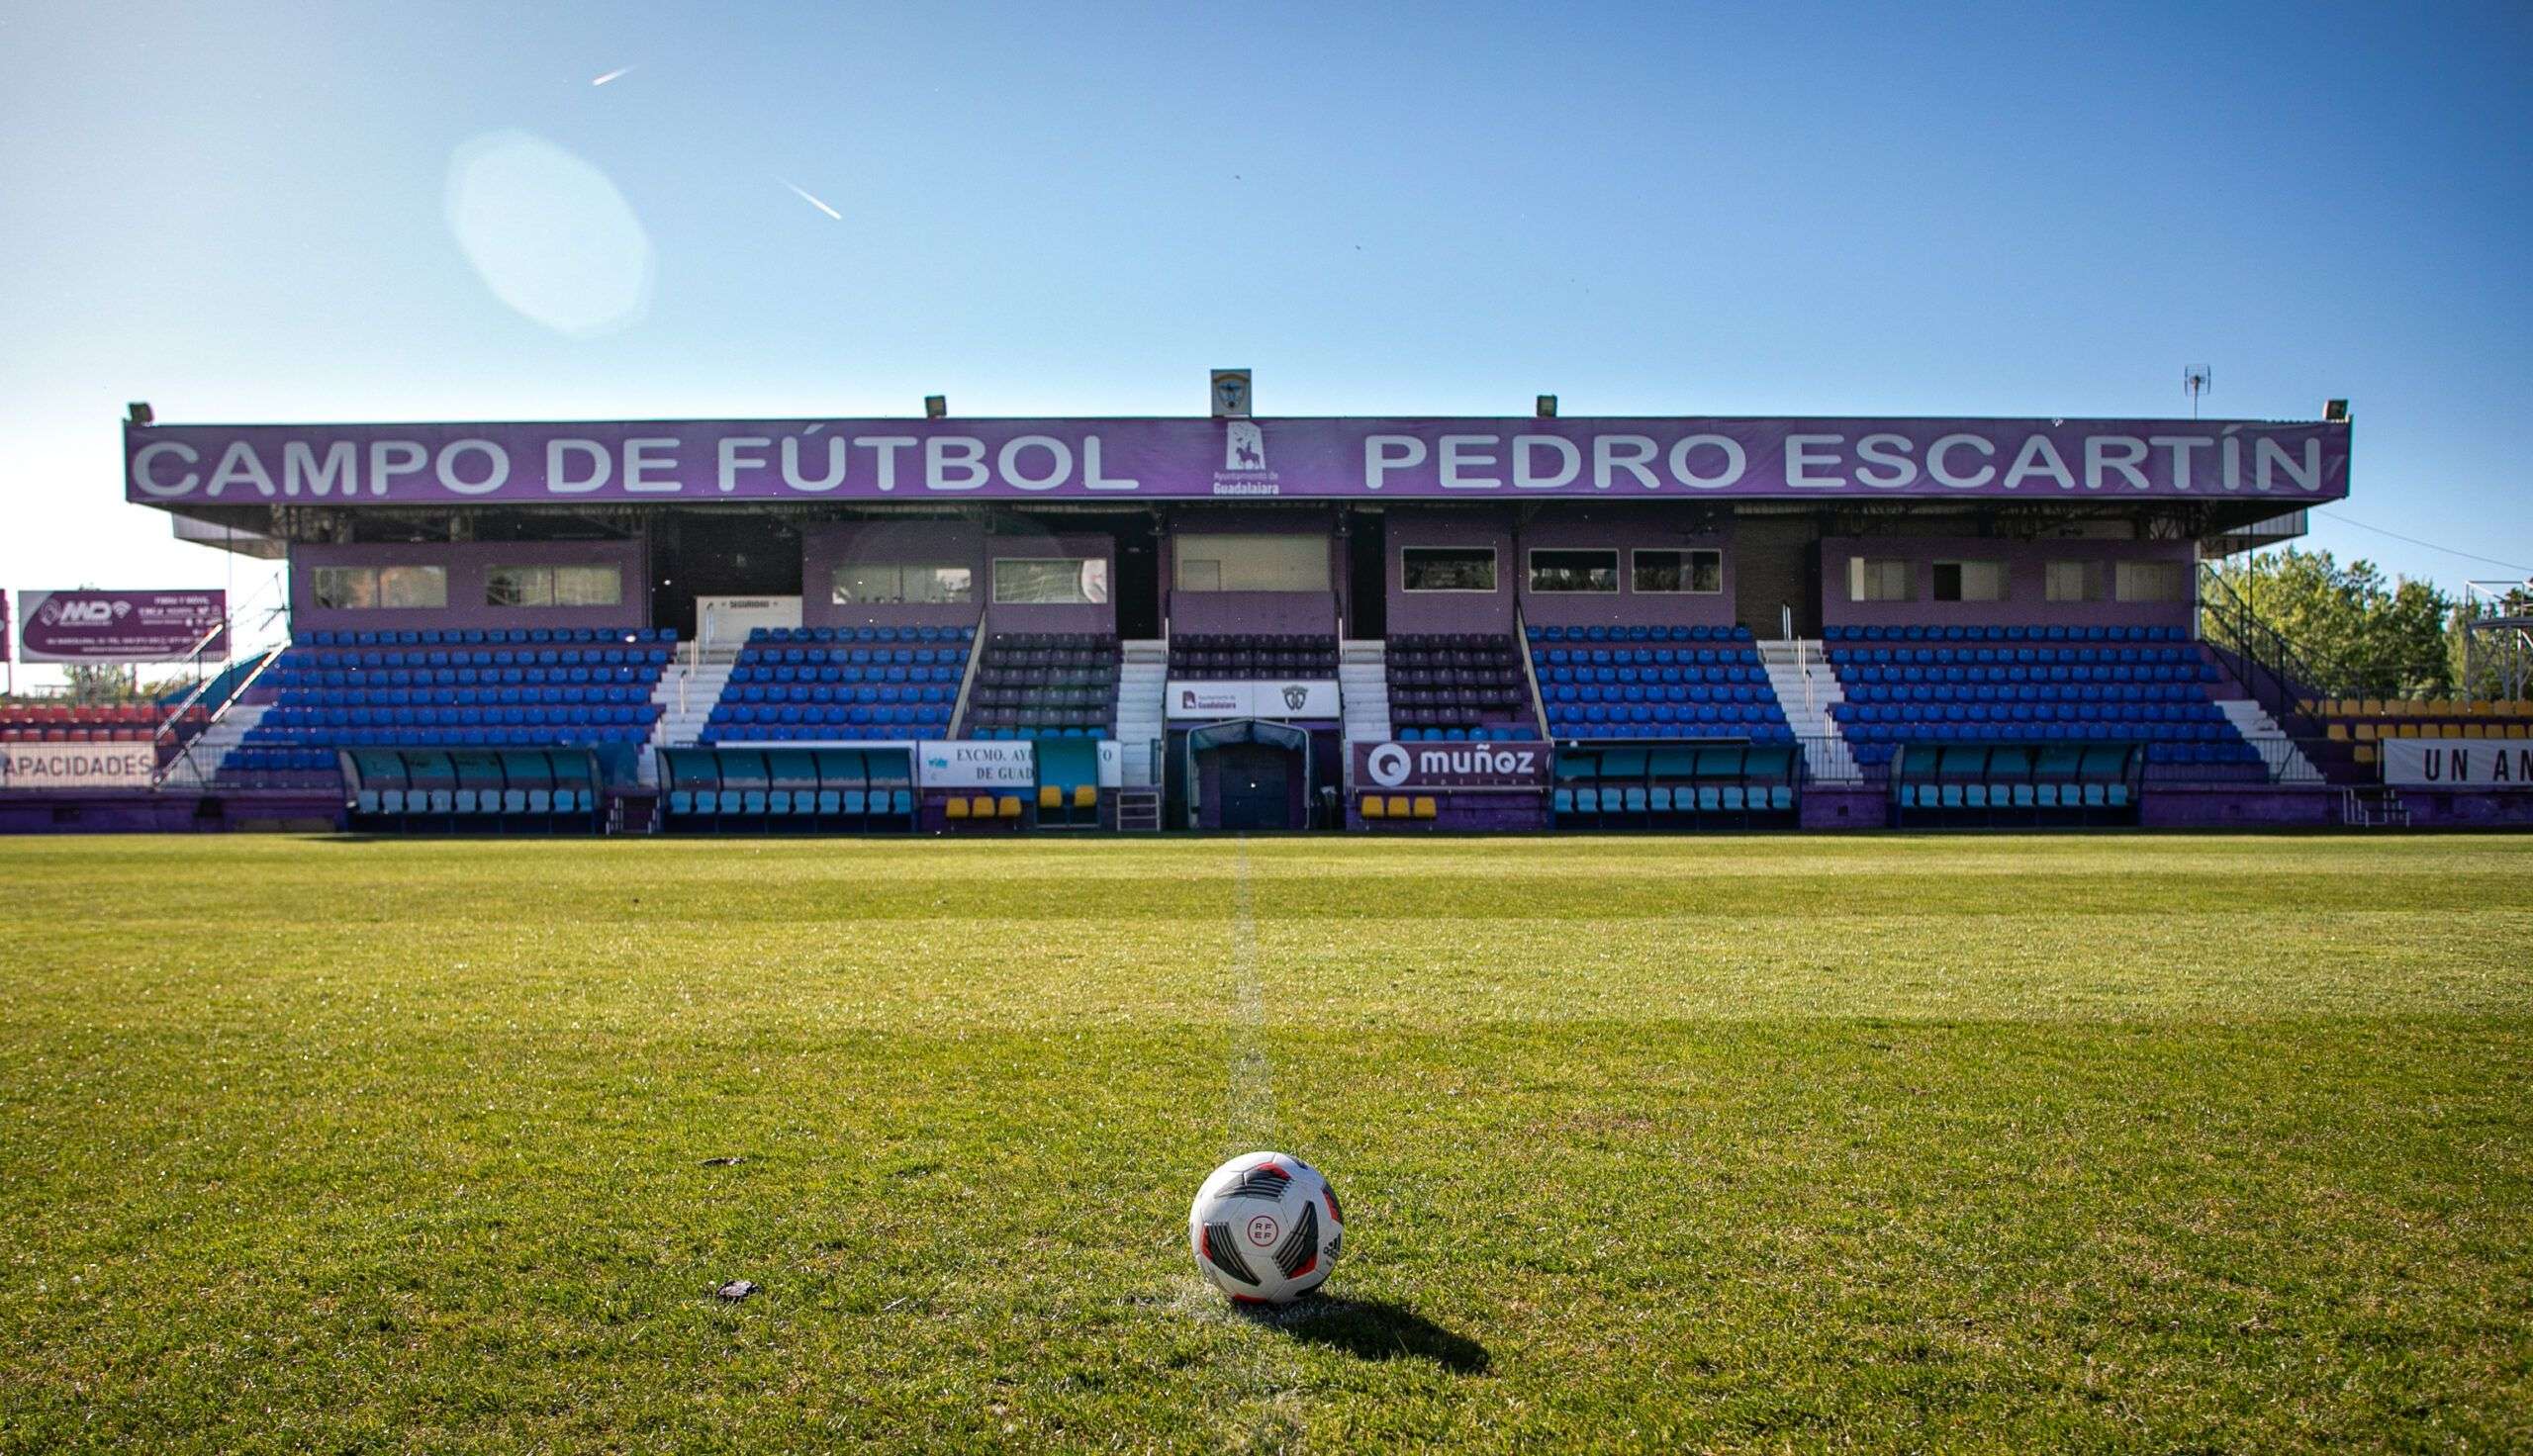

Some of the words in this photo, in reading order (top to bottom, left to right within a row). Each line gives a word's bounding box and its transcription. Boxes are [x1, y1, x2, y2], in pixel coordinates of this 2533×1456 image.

[132, 438, 511, 496] CAMPO
[546, 437, 683, 493] DE
[717, 423, 1140, 492] FÚTBOL
[1364, 433, 1747, 490] PEDRO
[1785, 424, 2321, 492] ESCARTÍN
[3, 755, 151, 776] APACIDADES
[956, 749, 1007, 762] EXCMO.
[1420, 744, 1536, 774] muñoz
[2425, 749, 2468, 781] UN
[976, 768, 993, 780] DE
